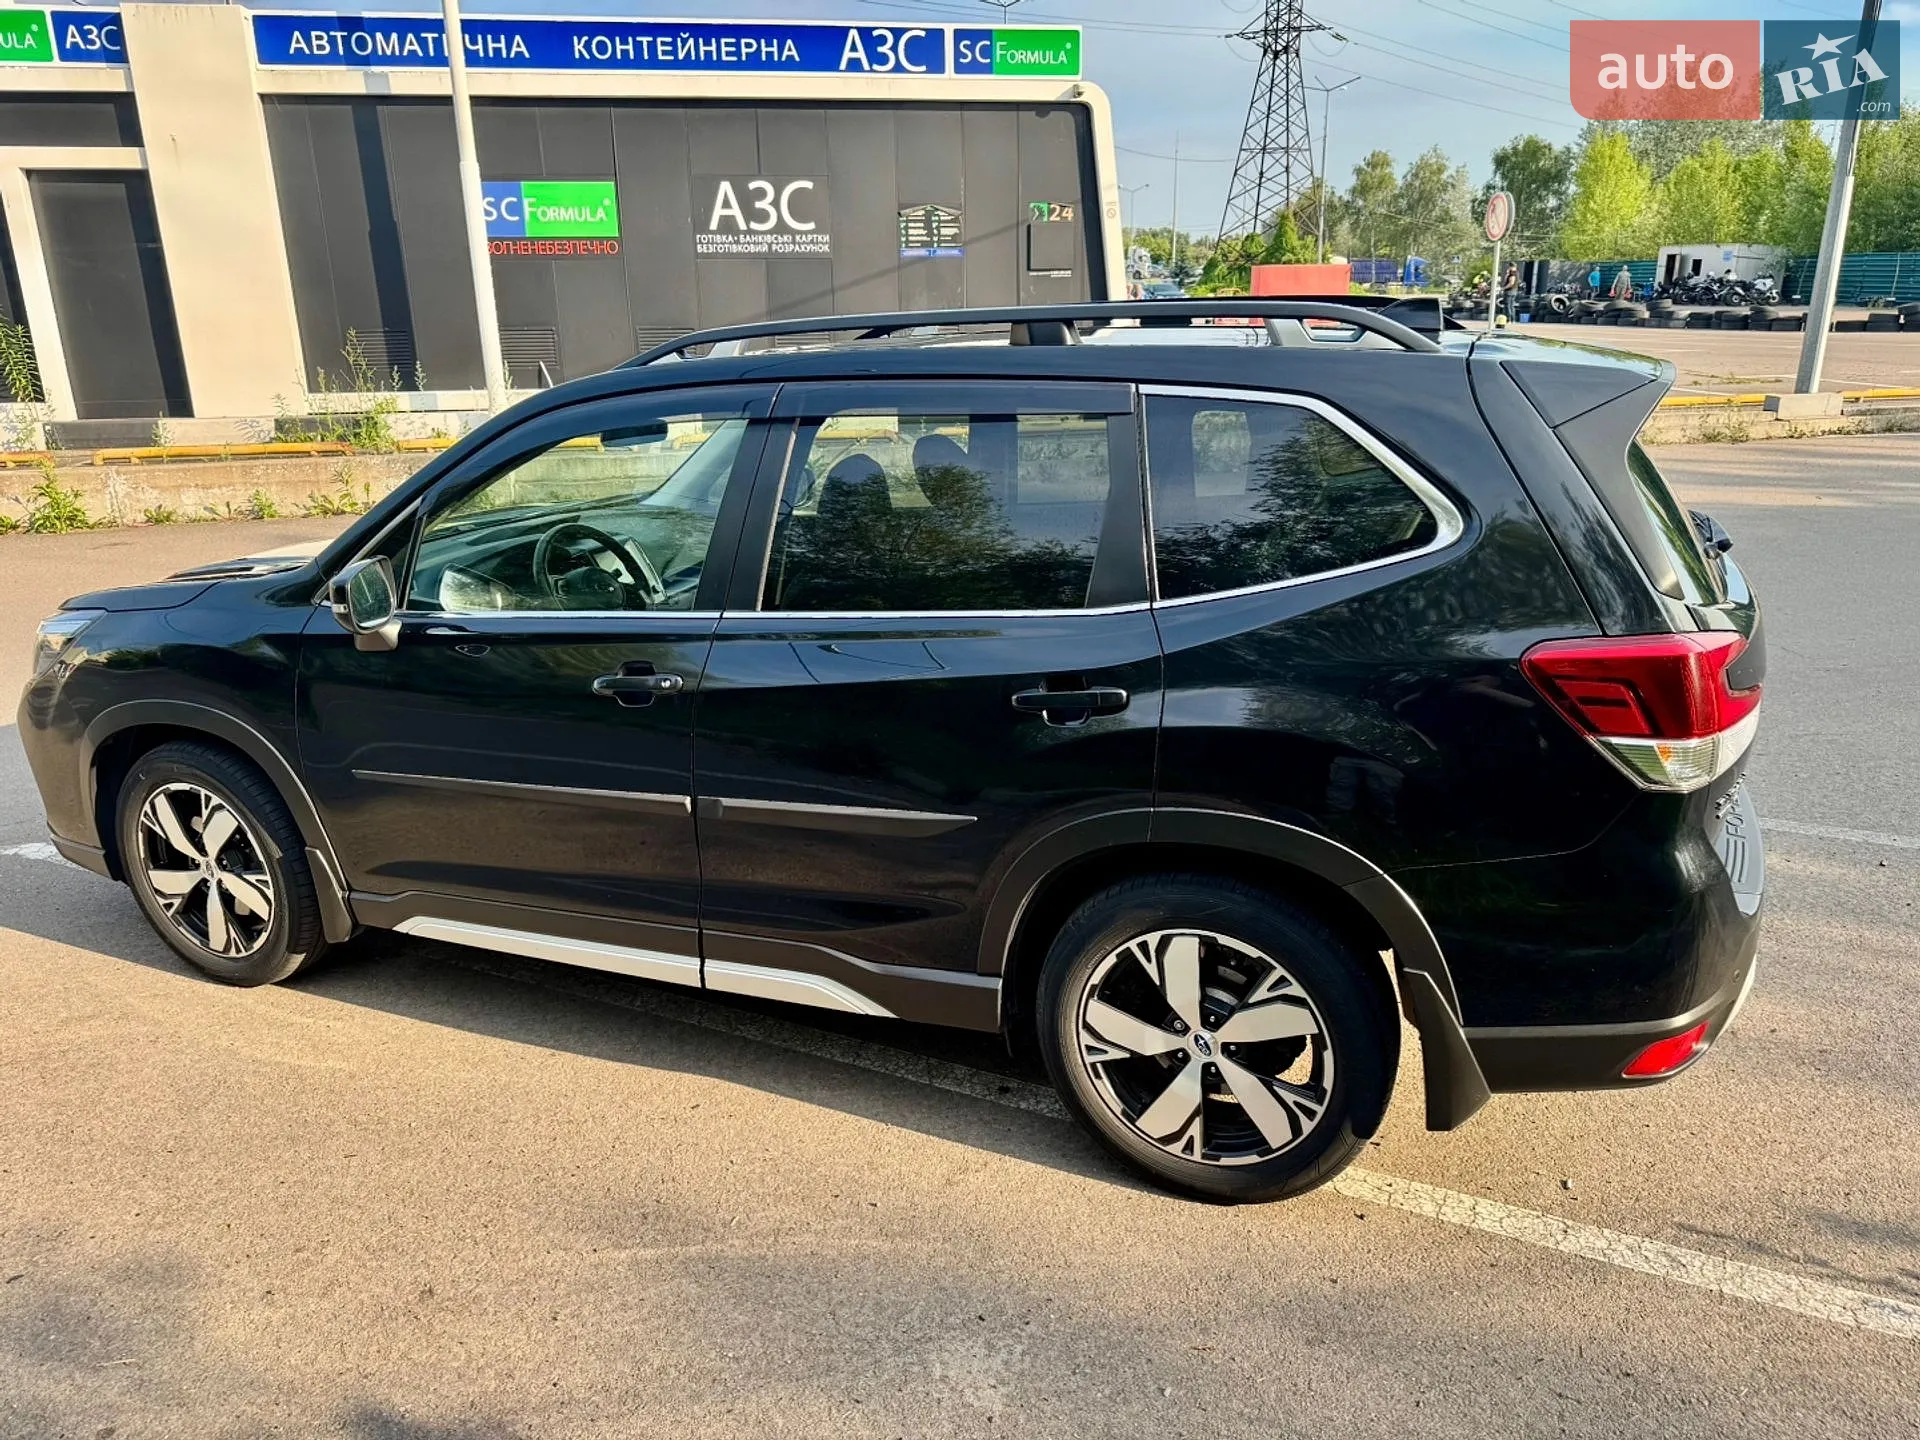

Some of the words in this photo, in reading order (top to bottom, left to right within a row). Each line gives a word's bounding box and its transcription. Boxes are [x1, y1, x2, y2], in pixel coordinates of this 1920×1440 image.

[0, 32, 37, 49] ULA
[65, 24, 121, 50] АЗС
[573, 32, 800, 62] КОНТЕЙНЕРНА
[839, 28, 928, 72] АЗС
[959, 40, 991, 63] SC
[996, 41, 1068, 64] FORMULA
[482, 197, 520, 221] SC
[525, 198, 607, 222] FORMULA
[709, 180, 816, 231] АЗС
[1049, 204, 1074, 222] 24
[697, 243, 768, 253] БЕЗГОТІВКОВИЙ
[772, 244, 830, 253] РОЗРАХУНОК
[739, 234, 792, 244] БАНКІВСЬКІ
[795, 234, 830, 244] КАРТКИ
